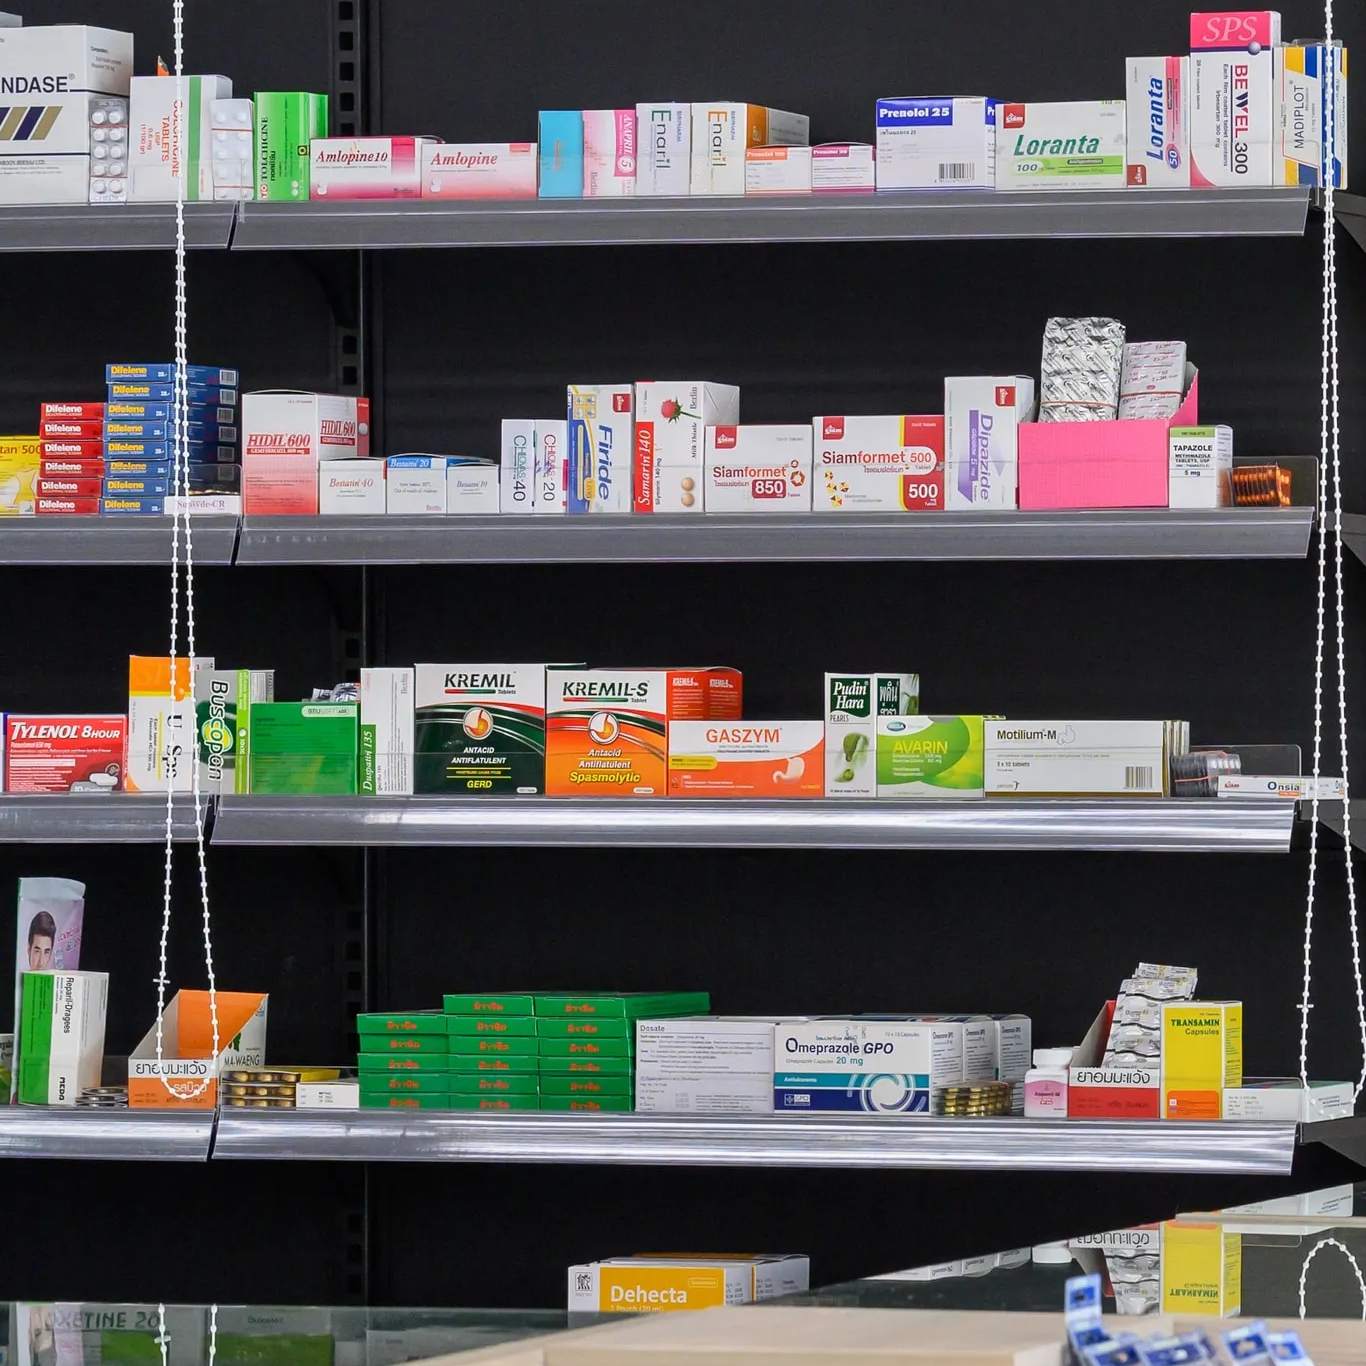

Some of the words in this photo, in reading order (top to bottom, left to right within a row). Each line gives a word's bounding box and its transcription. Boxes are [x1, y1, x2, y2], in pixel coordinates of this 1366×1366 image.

[1202, 16, 1258, 43] SPS
[879, 107, 930, 119] Prenolol
[931, 106, 951, 118] 25
[1146, 76, 1164, 161] Loranta
[1293, 85, 1305, 149] MADIPLOT
[651, 109, 672, 169] Enaril
[707, 109, 728, 167] Enaril
[1013, 134, 1101, 157] Loranta
[430, 151, 498, 167] Amlopine
[1234, 142, 1249, 175] 300
[1016, 163, 1039, 173] 100
[111, 366, 147, 375] Difelene
[689, 386, 698, 410] Berlin
[45, 404, 83, 413] Difelene
[44, 424, 82, 433] Difelene
[44, 443, 82, 452] Difelene
[247, 434, 286, 448] HIDIL
[286, 434, 311, 447] 600
[637, 429, 652, 453] 140
[1172, 444, 1213, 453] TAPAZOLE
[597, 423, 613, 501] Firide
[822, 450, 906, 465] Siamformet
[909, 452, 932, 464] 500
[980, 413, 993, 502] Dipazide
[45, 462, 82, 471] Difelene
[712, 465, 787, 478] Siamformet
[40, 481, 78, 491] Difelene
[637, 453, 651, 506] Samarin
[754, 480, 784, 495] 850
[908, 483, 939, 499] 500
[444, 673, 515, 688] KREMIL
[562, 681, 649, 697] KREMIL-S
[832, 681, 867, 697] Pudin
[836, 695, 864, 710] Hara
[10, 721, 80, 740] TYLENOL
[203, 679, 230, 781] Buscopan
[363, 729, 373, 745] 135
[705, 728, 781, 744] GASZYM
[463, 746, 495, 754] ANTACID
[588, 748, 621, 757] Antacid
[892, 740, 948, 755] AVARIN
[451, 756, 506, 765] ANTIFLATULENT
[578, 759, 631, 770] Antiflatulent
[362, 747, 373, 792] Duspatin
[569, 770, 641, 784] Spasmolytic
[466, 780, 493, 789] GERD
[1267, 780, 1300, 792] Onsia
[1171, 1019, 1220, 1027] TRANSAMIN
[1184, 1028, 1220, 1037] Capsules
[785, 1037, 860, 1055] Omeprazole
[863, 1042, 895, 1055] GPO
[836, 1056, 847, 1065] 20
[849, 1057, 864, 1067] mg
[1077, 1069, 1151, 1084] ยาอมมะแว้ง
[610, 1285, 687, 1304] Dehecta
